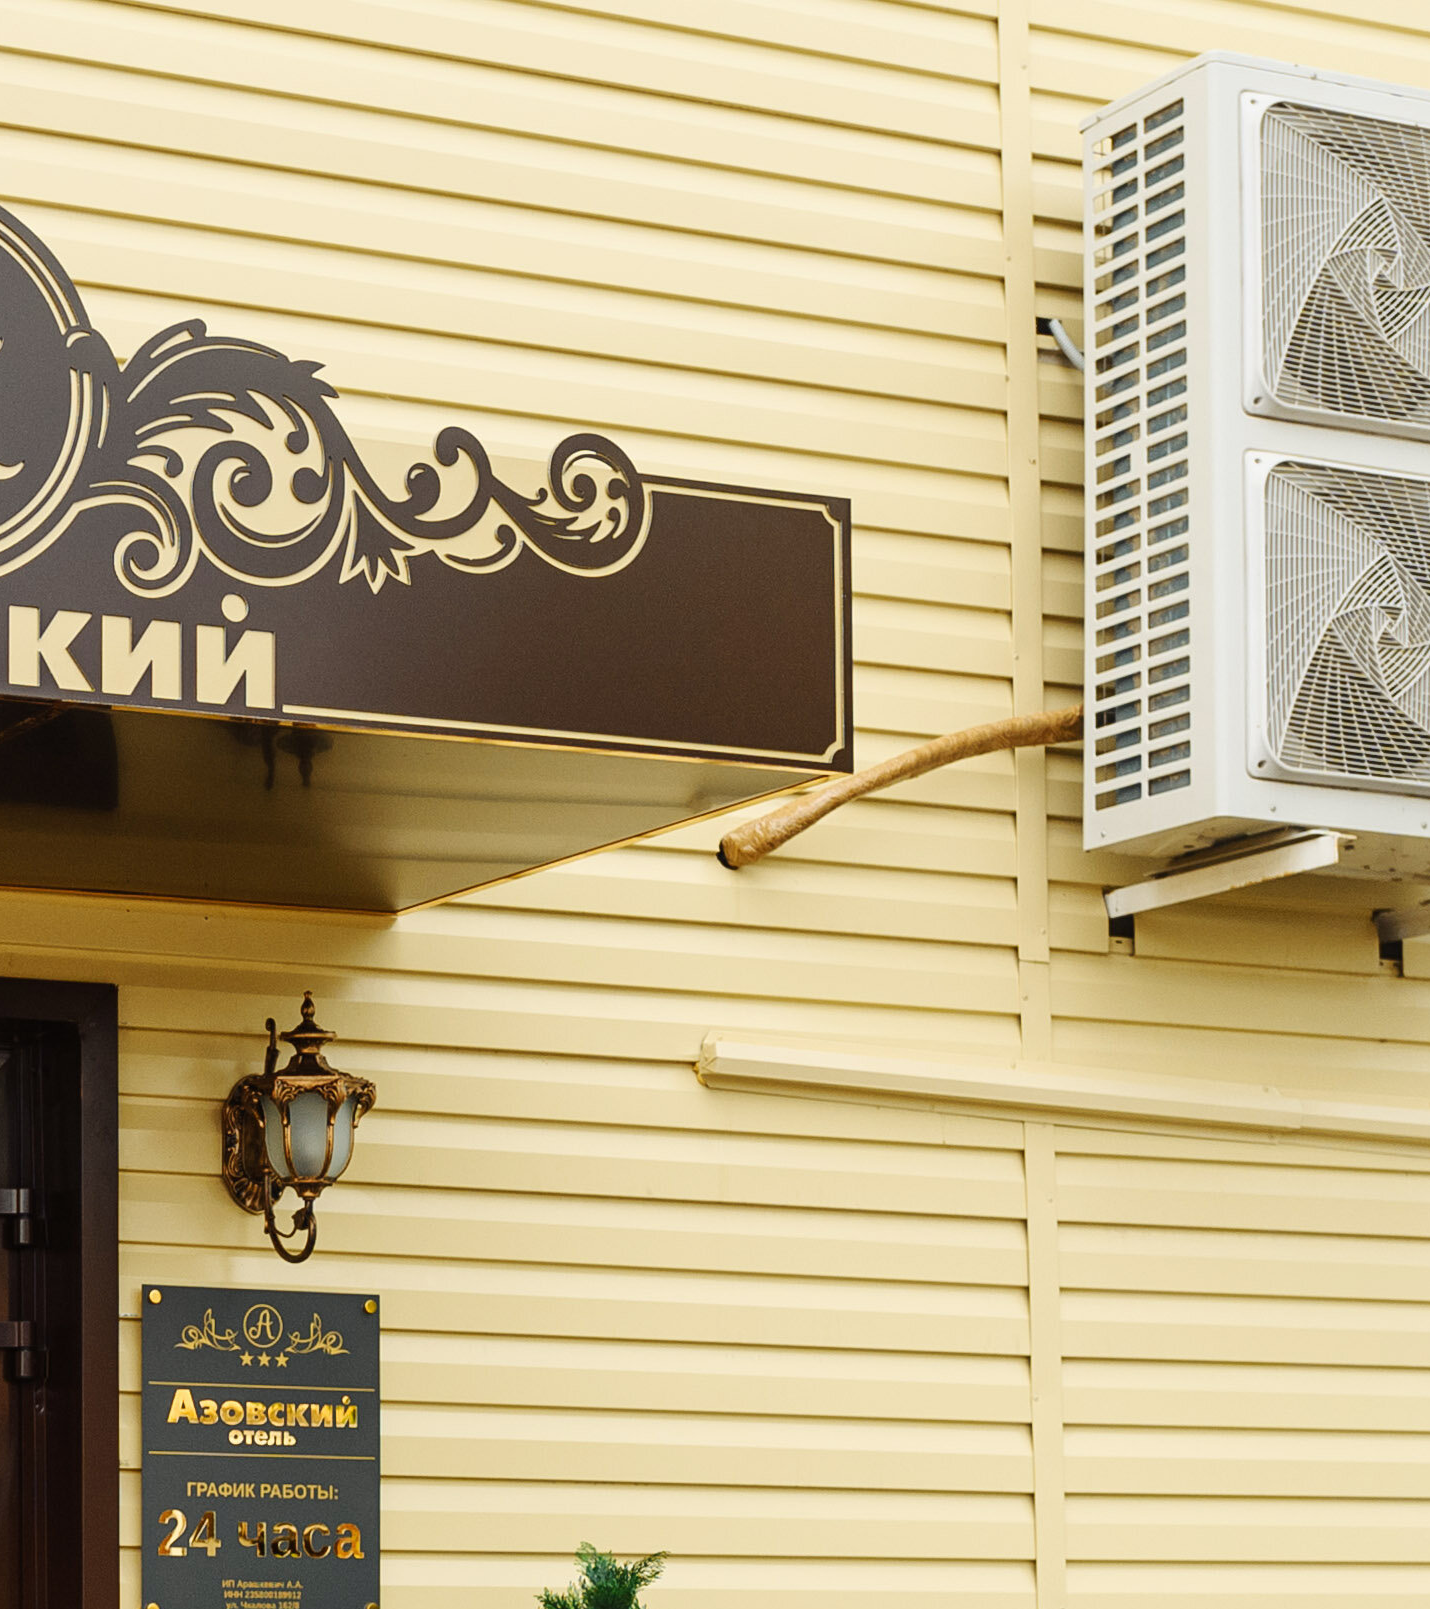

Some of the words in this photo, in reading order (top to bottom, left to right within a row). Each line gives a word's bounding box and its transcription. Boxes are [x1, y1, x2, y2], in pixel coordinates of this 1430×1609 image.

[166, 1388, 358, 1428] Азовский
[228, 1429, 297, 1446] отель
[186, 1481, 256, 1498] ГРАФИК
[260, 1484, 340, 1500] РАБОТЫ:
[157, 1508, 222, 1557] 24
[238, 1521, 366, 1560] часа
[222, 1579, 235, 1588] ИП
